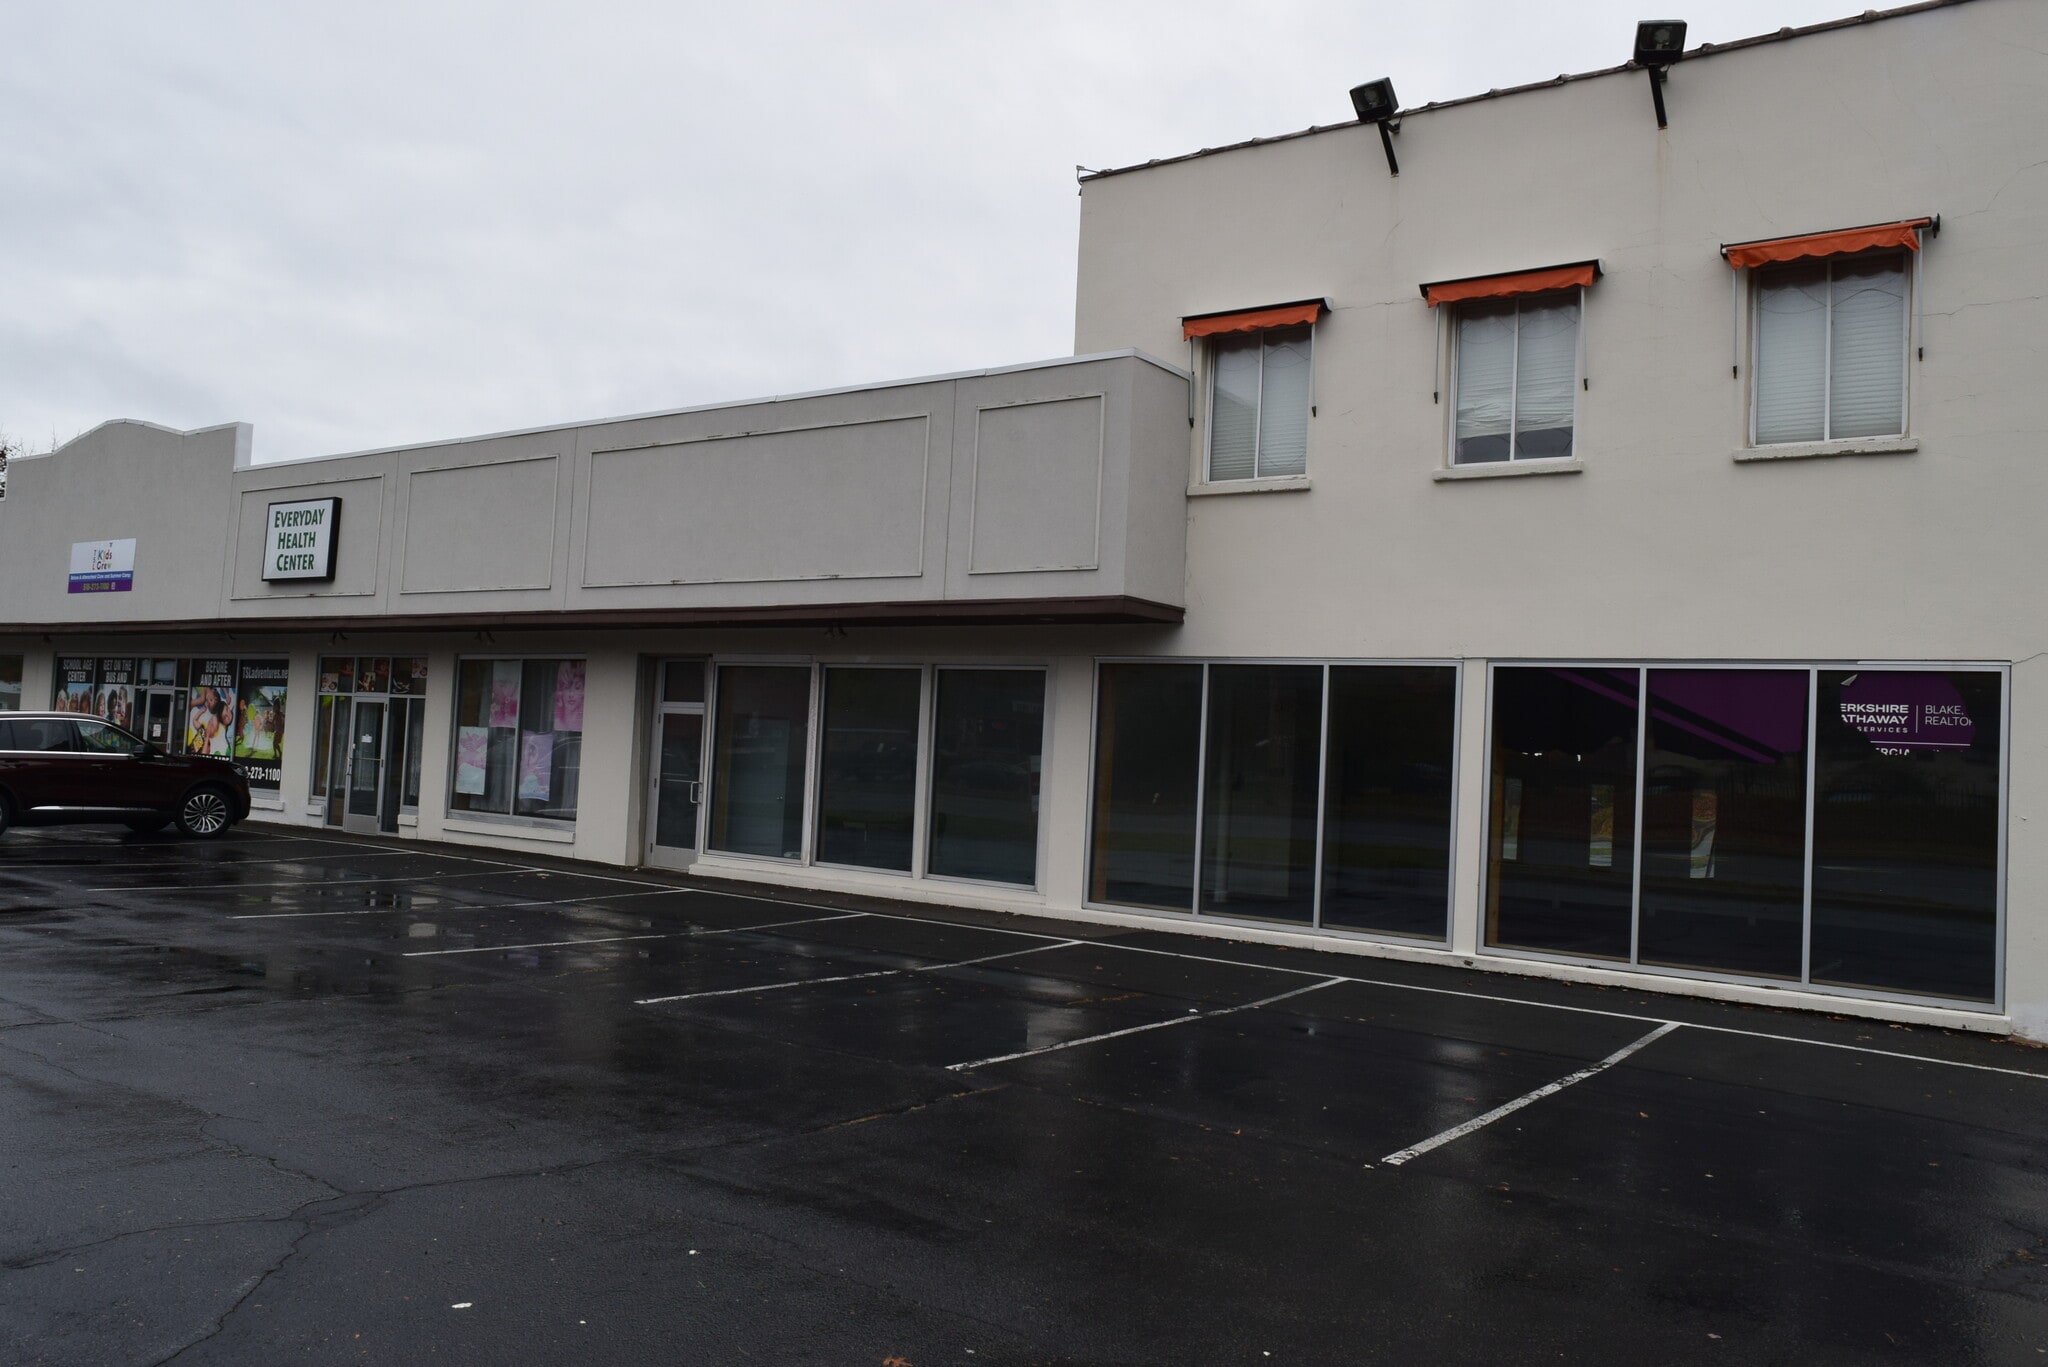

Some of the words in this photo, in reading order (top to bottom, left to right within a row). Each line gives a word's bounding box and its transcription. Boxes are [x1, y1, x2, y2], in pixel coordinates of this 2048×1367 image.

[274, 508, 325, 528] EVERYDAY
[277, 531, 316, 550] HEALTH
[276, 553, 315, 571] CENTER
[63, 659, 82, 670] SCHOOL
[83, 659, 92, 670] AGE
[103, 660, 113, 670] GET
[113, 660, 121, 670] ON
[122, 660, 132, 671] THE
[205, 661, 228, 673] BEFORE
[67, 671, 86, 681] CENTER
[105, 672, 116, 682] BUS
[116, 672, 128, 683] AND
[200, 674, 212, 685] AND
[212, 674, 232, 686] AFTER
[1840, 703, 1909, 713] ERKSHIRE
[1925, 704, 1964, 715] BLAKE,
[1841, 714, 1908, 724] ATHAWAY
[245, 765, 281, 781] -273-1100
